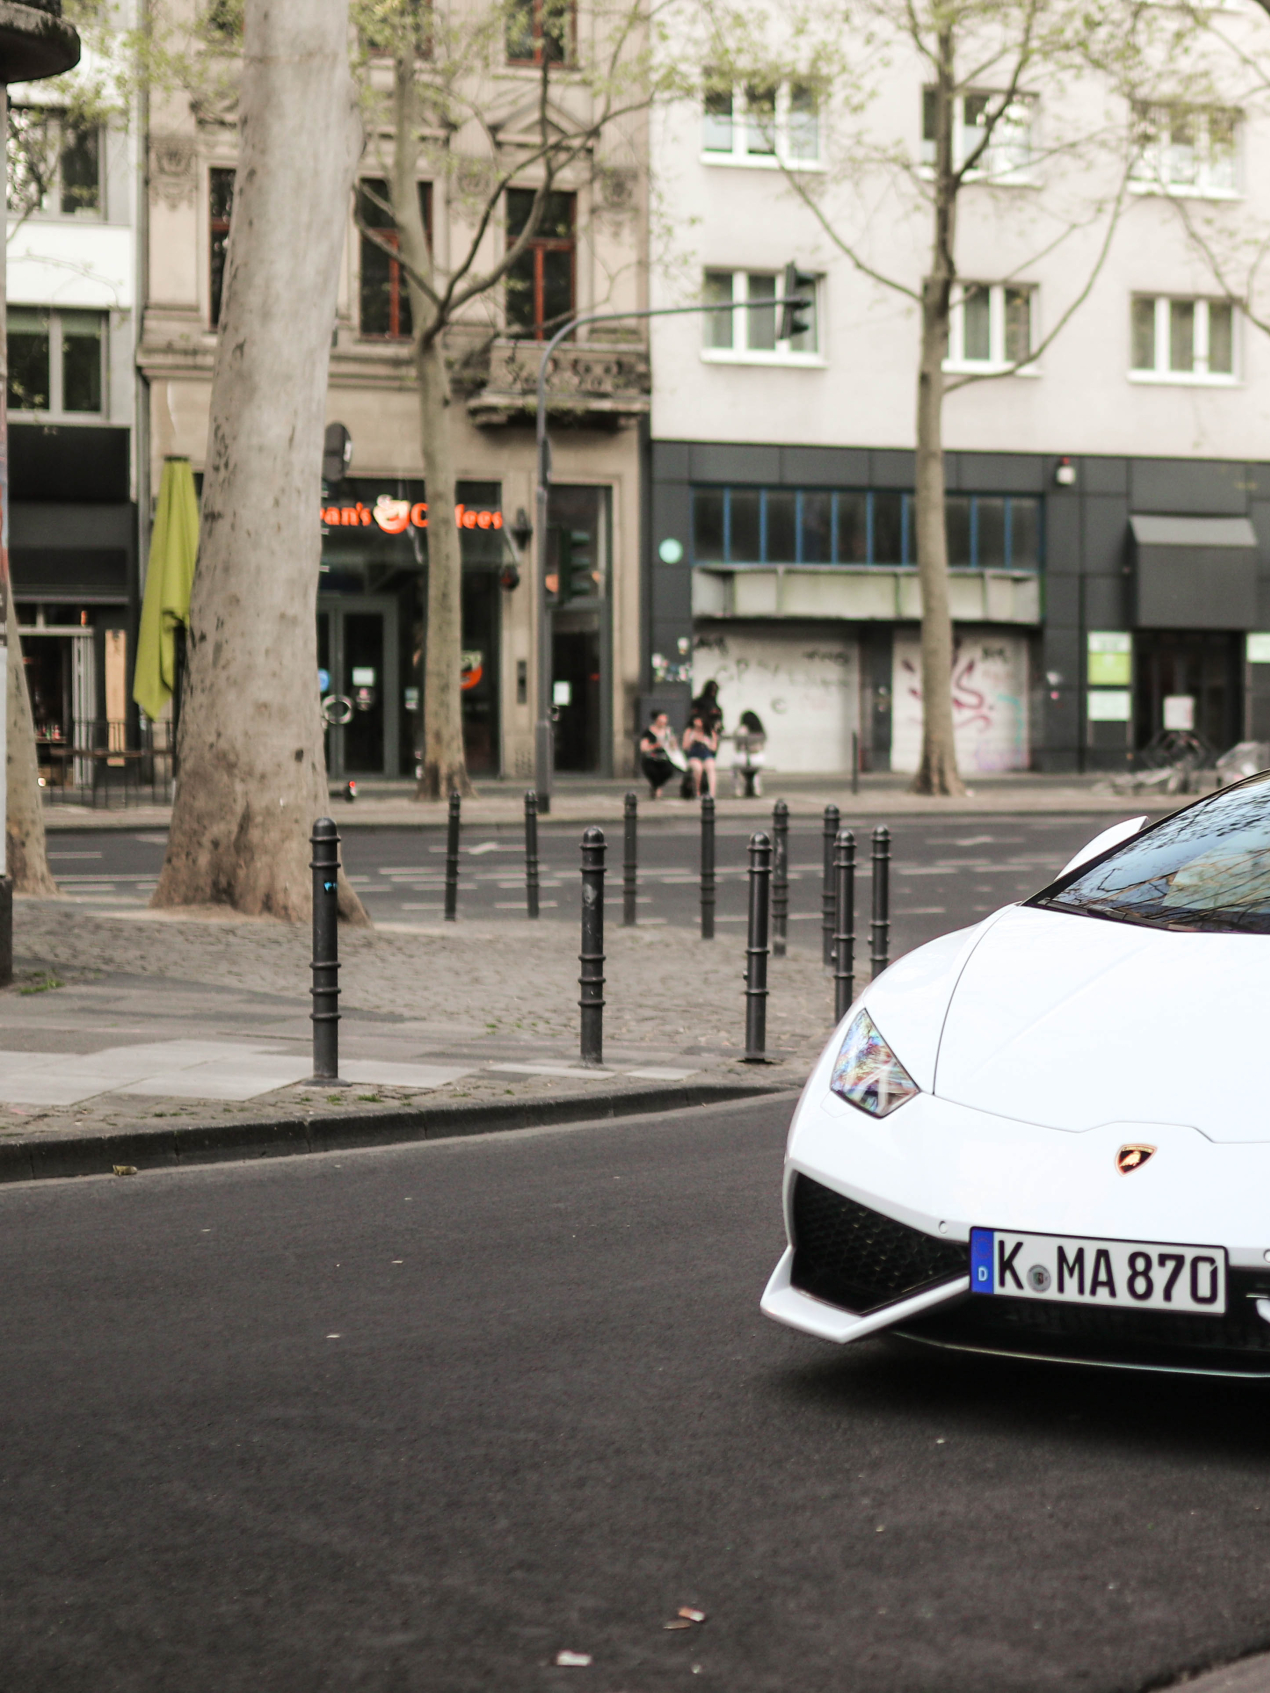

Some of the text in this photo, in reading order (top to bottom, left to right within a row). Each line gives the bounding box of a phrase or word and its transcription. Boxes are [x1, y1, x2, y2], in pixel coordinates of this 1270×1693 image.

[320, 502, 372, 526] an's
[977, 1266, 989, 1282] D
[998, 1239, 1025, 1291] K
